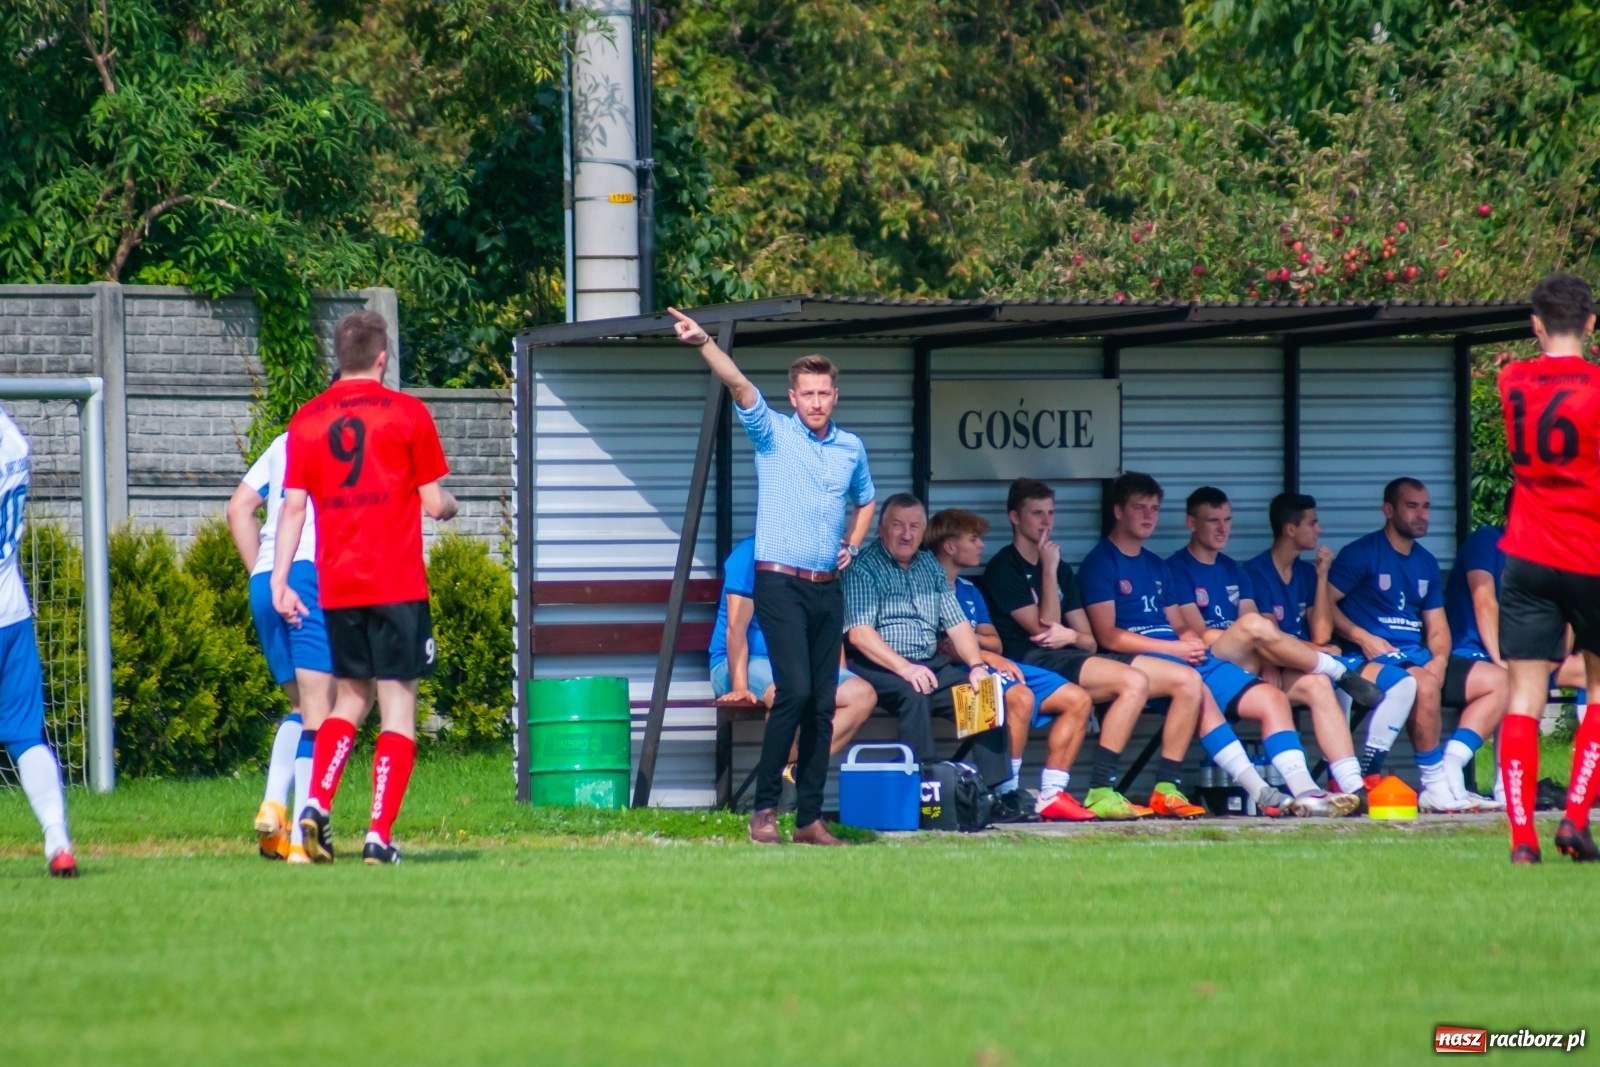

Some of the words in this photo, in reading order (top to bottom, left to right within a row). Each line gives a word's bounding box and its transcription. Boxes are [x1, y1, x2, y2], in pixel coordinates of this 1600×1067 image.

[327, 413, 366, 489] 9
[958, 398, 1094, 449] GOŚCIE
[1508, 387, 1579, 467] 16
[425, 637, 435, 664] 9
